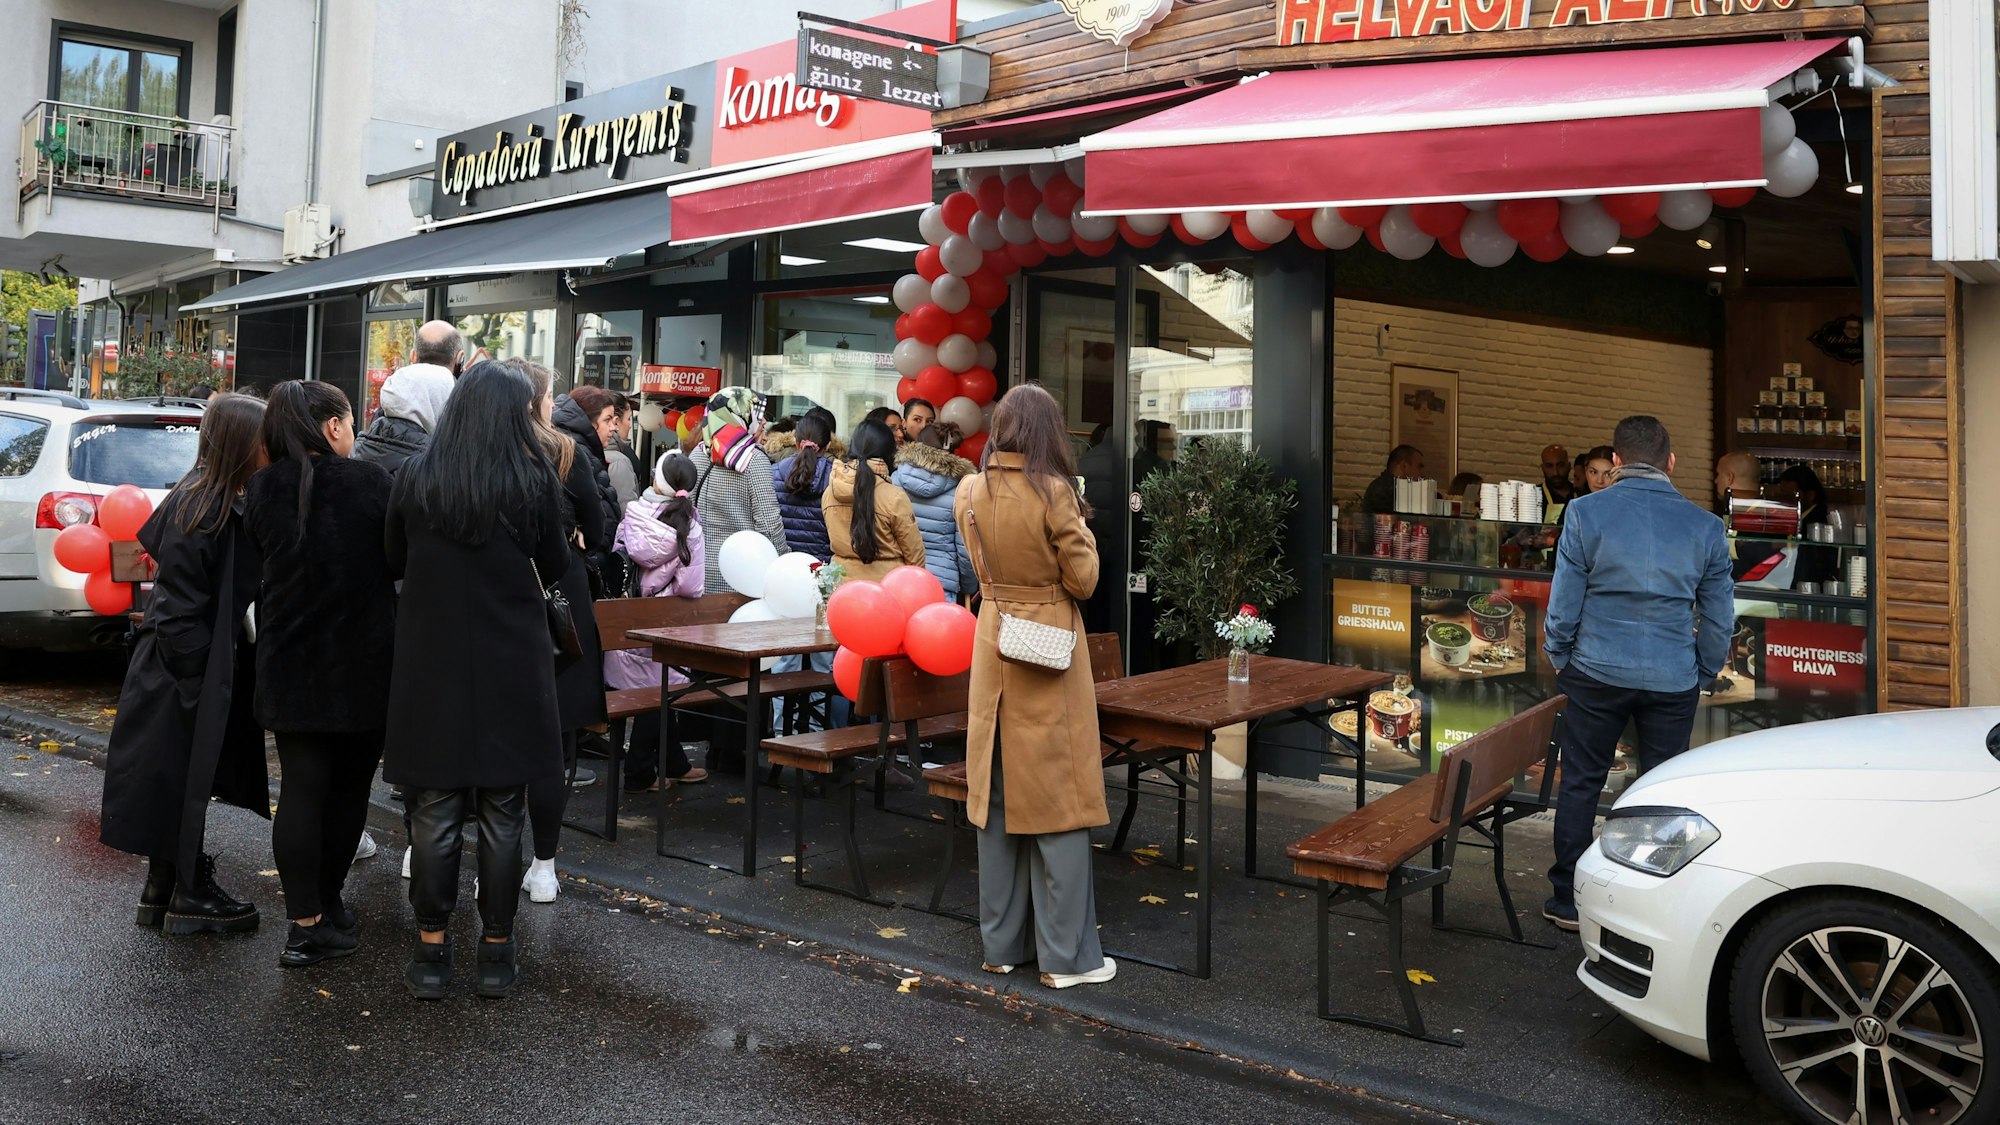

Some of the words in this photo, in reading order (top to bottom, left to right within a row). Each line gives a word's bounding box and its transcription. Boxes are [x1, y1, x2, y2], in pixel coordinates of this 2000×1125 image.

[1106, 4, 1131, 23] 1900
[809, 36, 893, 69] komagene
[881, 80, 942, 108] lezzet
[441, 122, 544, 206] Capadocia
[551, 84, 684, 179] Kuruyemiş
[641, 366, 705, 389] komagene
[677, 384, 693, 392] come
[693, 385, 711, 394] again
[165, 425, 201, 434] DAM
[1351, 603, 1391, 617] BUTTER
[1337, 615, 1406, 632] GRIESSHALVA
[1792, 660, 1837, 676] HALVA
[1444, 728, 1479, 741] PISTA
